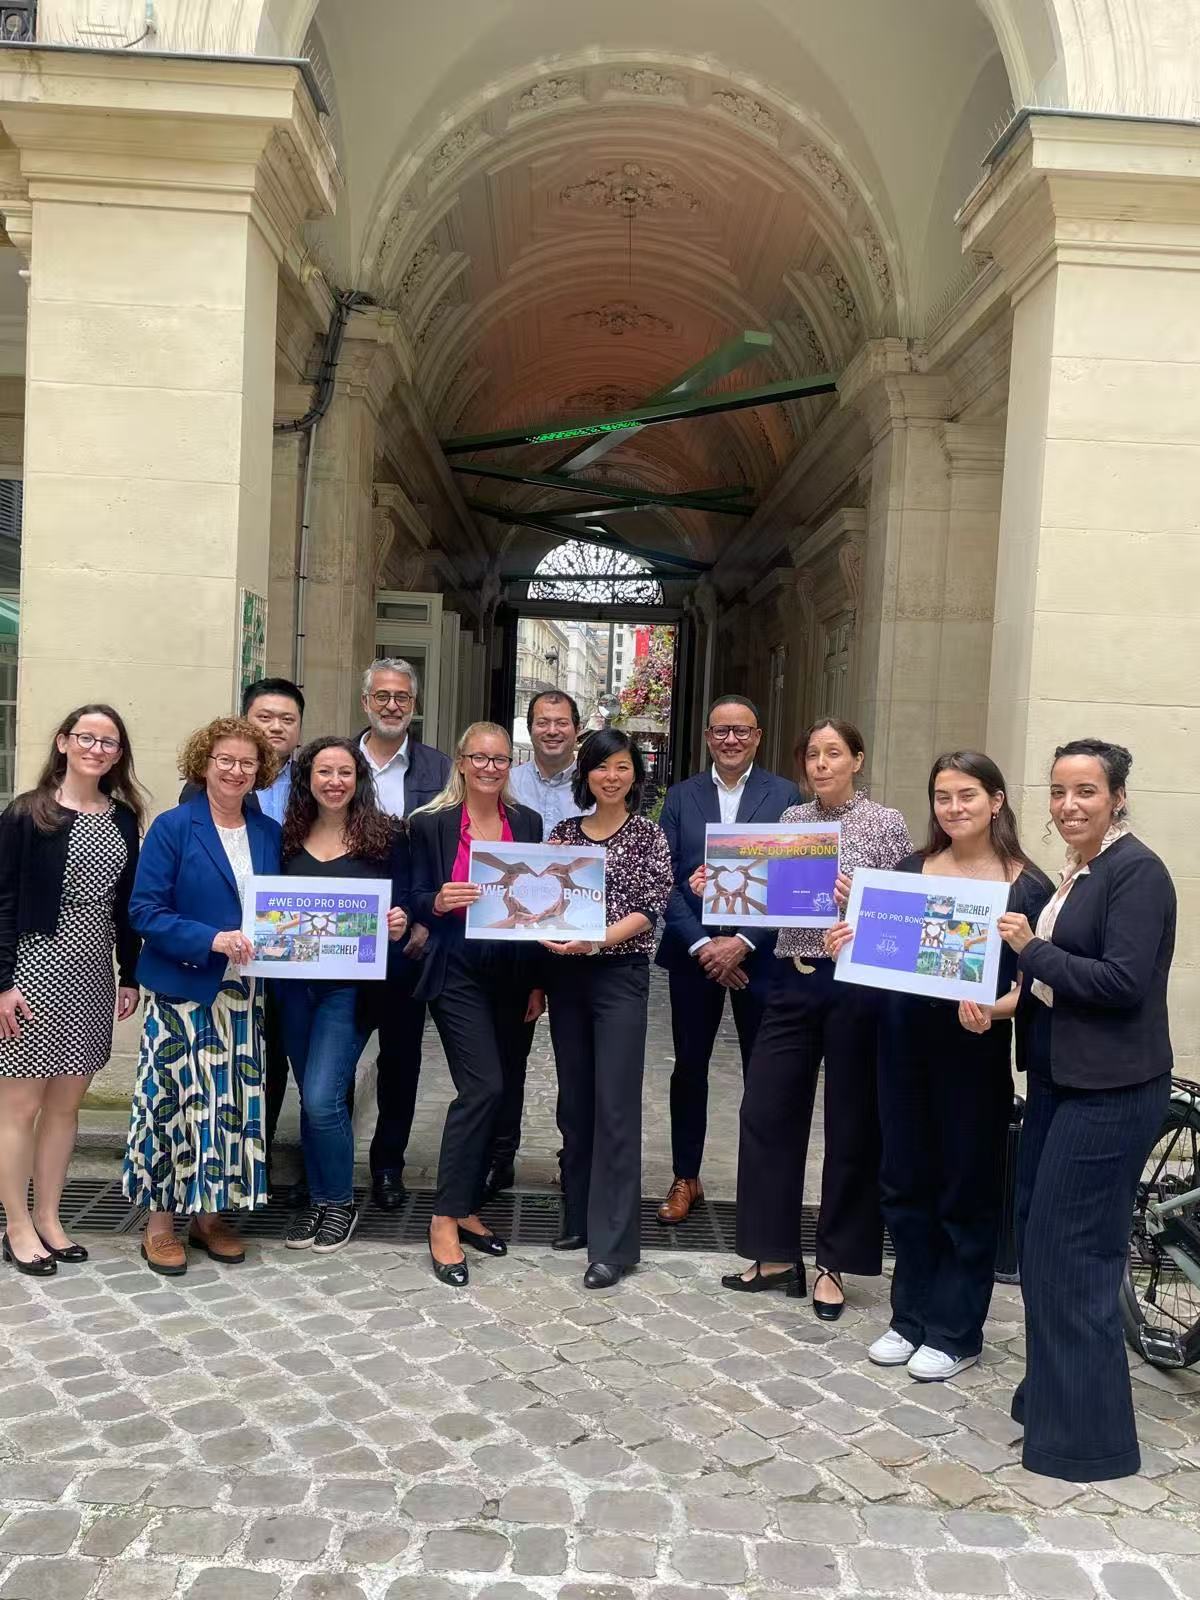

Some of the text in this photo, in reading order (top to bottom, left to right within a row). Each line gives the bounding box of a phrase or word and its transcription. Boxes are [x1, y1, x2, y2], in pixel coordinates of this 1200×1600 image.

[740, 844, 838, 855] #WE DO PRO BONO
[563, 888, 601, 901] BONO
[268, 897, 367, 909] #WE DO PRO BONO
[877, 912, 888, 920] DO
[889, 913, 903, 921] PRO
[904, 915, 924, 925] BONO
